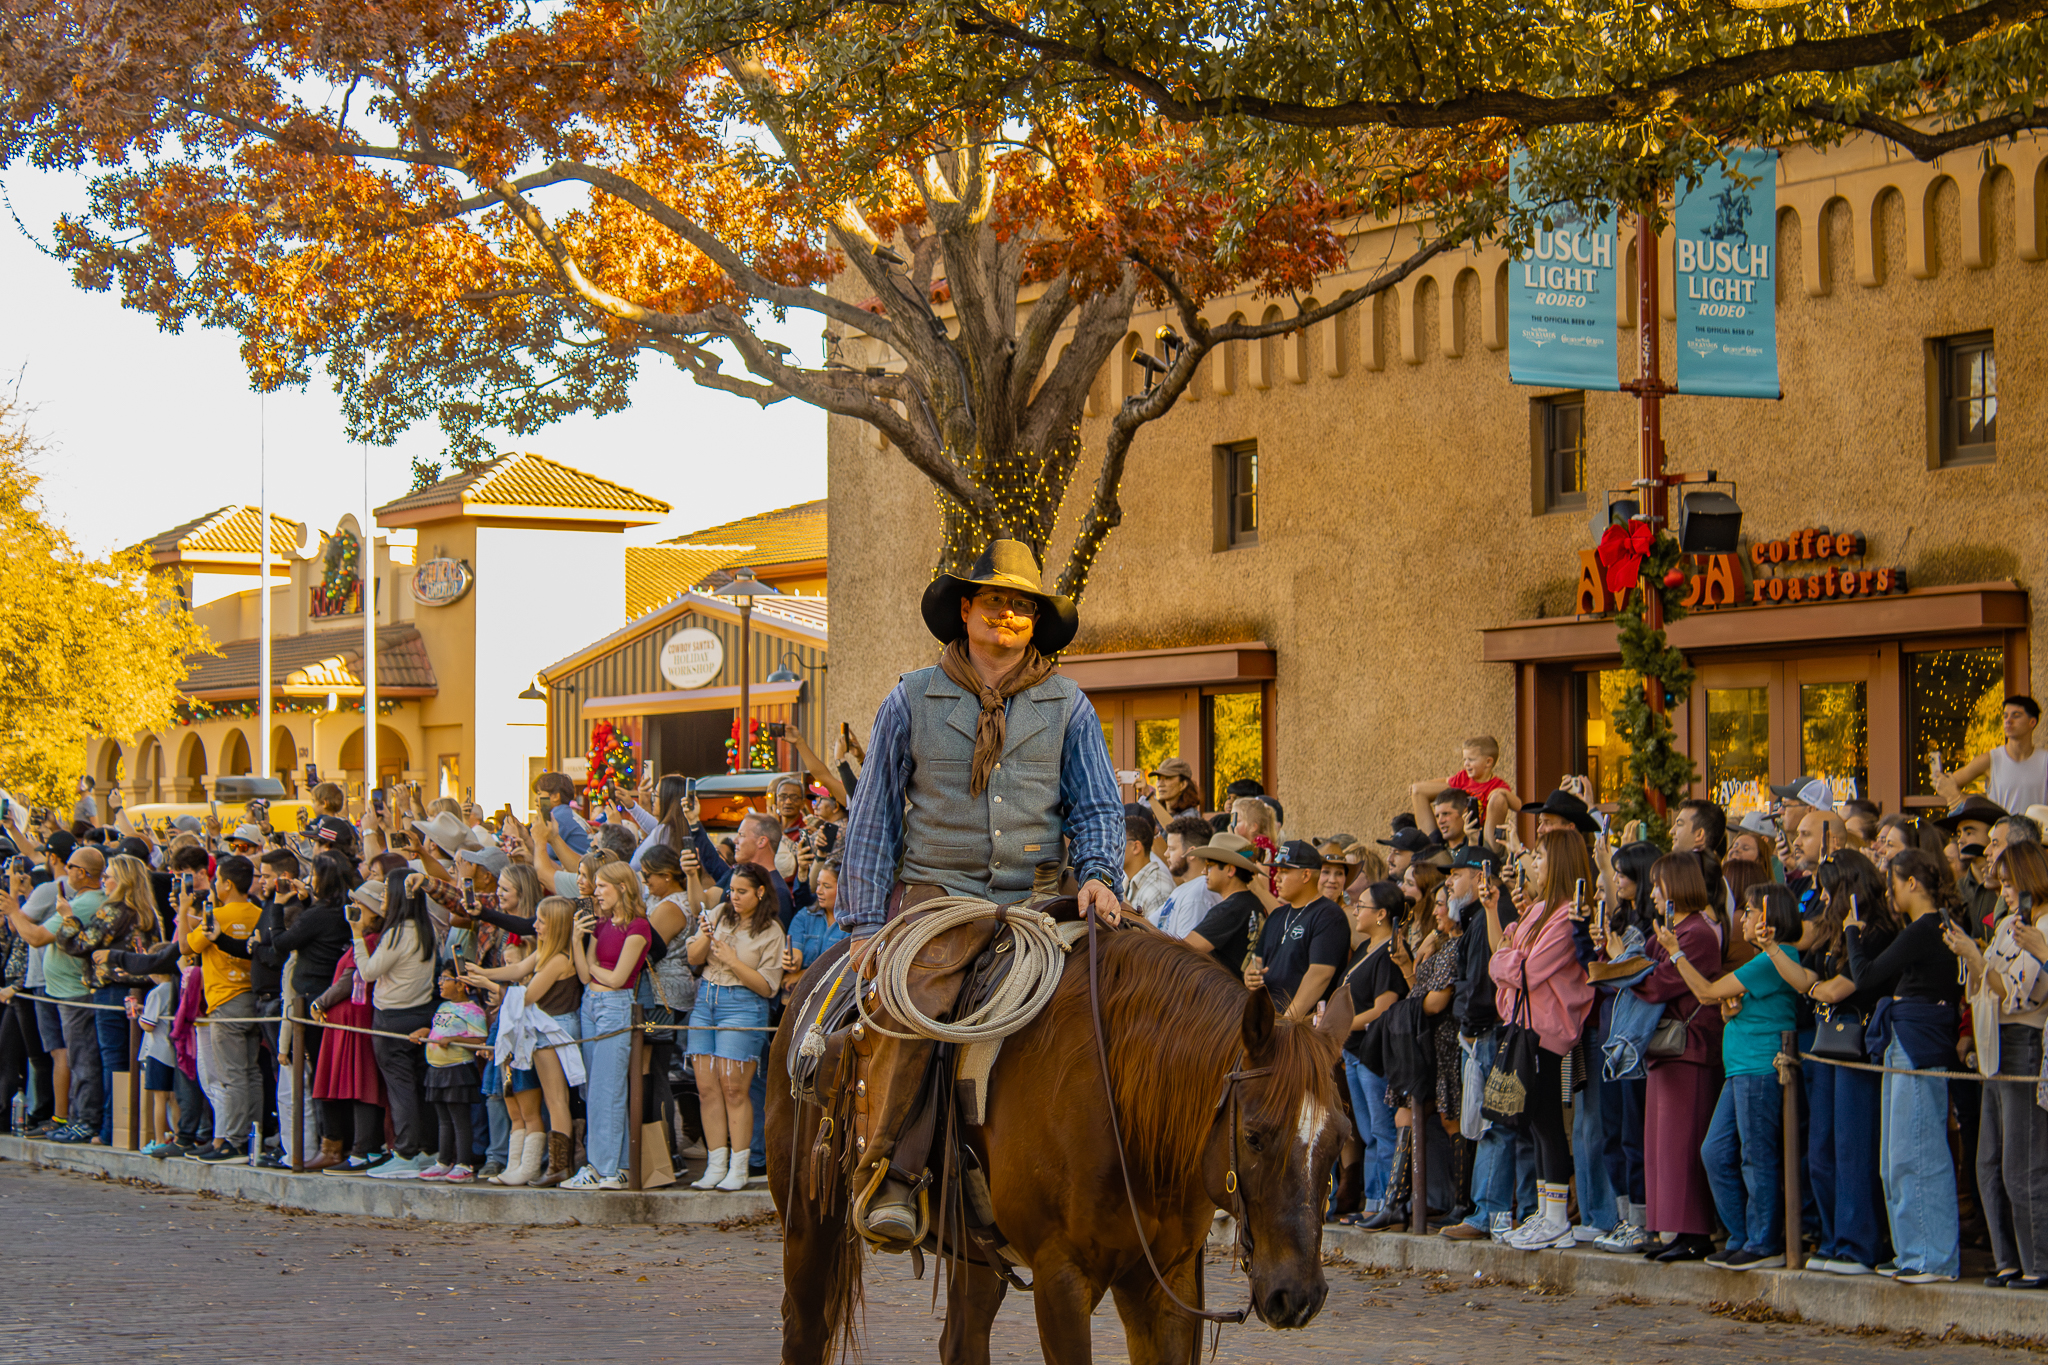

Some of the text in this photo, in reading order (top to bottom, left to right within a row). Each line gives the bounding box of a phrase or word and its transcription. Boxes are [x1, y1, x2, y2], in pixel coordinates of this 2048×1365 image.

[1678, 238, 1769, 278] BUSCH
[1524, 264, 1598, 292] LIGHT
[1688, 275, 1756, 302] LIGHT
[1535, 292, 1587, 308] RODEO
[1698, 303, 1746, 318] RODEO
[1544, 316, 1570, 325] OFFICIAL
[1706, 327, 1731, 335] OFFICIAL
[1751, 528, 1851, 565] coffee
[1752, 566, 1890, 602] roasters
[667, 639, 715, 654] COWBOY SANTA'S
[667, 662, 715, 676] WORKSHOP
[673, 652, 708, 665] HOLIDAY
[1719, 777, 1759, 805] AVOCA
[1825, 774, 1859, 801] VOCA
